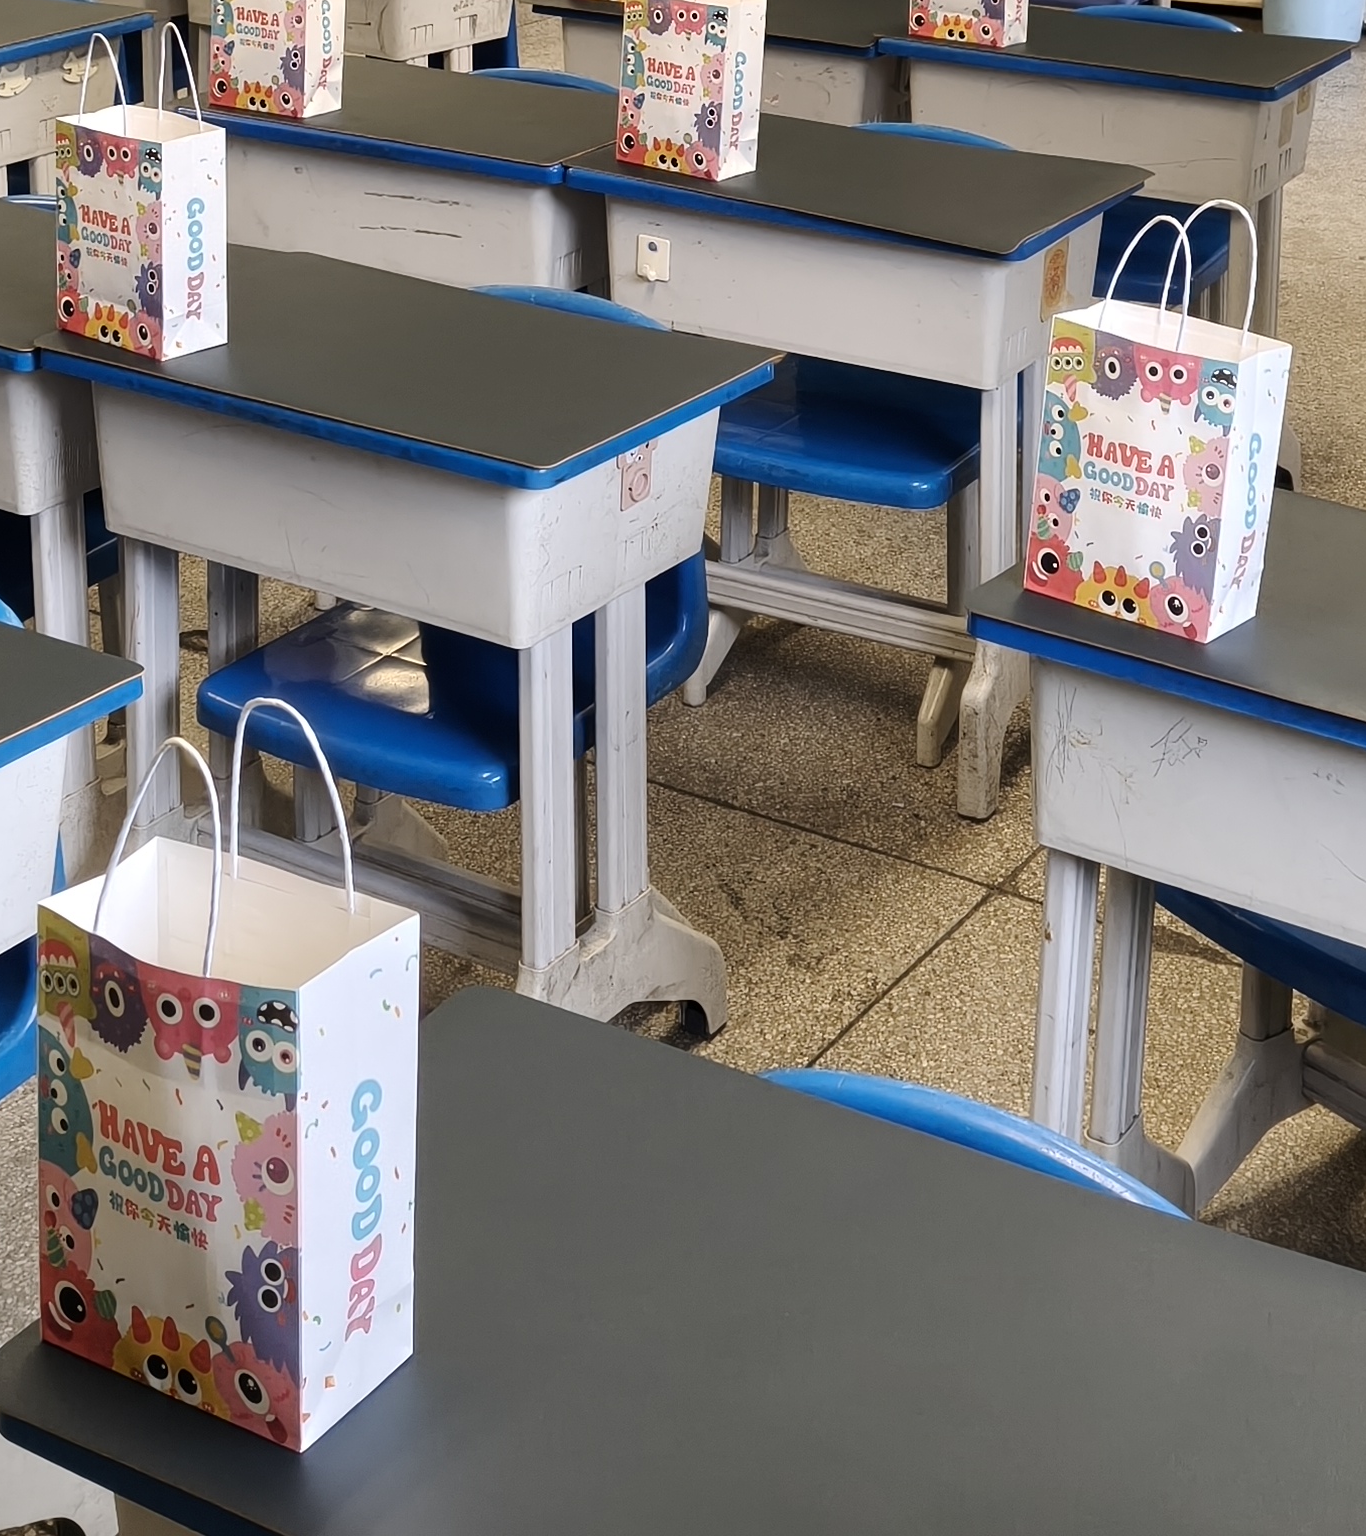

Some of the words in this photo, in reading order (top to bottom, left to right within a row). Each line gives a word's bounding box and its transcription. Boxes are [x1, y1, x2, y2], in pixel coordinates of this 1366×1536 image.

[237, 7, 268, 26] HAVE
[271, 13, 279, 26] A
[648, 57, 682, 79] HAVE
[686, 67, 695, 81] A
[81, 205, 118, 232] HAVE
[122, 217, 131, 236] A
[187, 198, 204, 271] GOOD
[1087, 433, 1153, 473] HAVE
[1157, 455, 1175, 479] A
[1089, 487, 1162, 519] 祝你今天愉快
[99, 1099, 186, 1169] HAVE
[193, 1144, 220, 1185] A
[351, 1078, 383, 1242] GOOD
[109, 1189, 209, 1250] 祝你今天愉快
[345, 1233, 383, 1342] DAY
